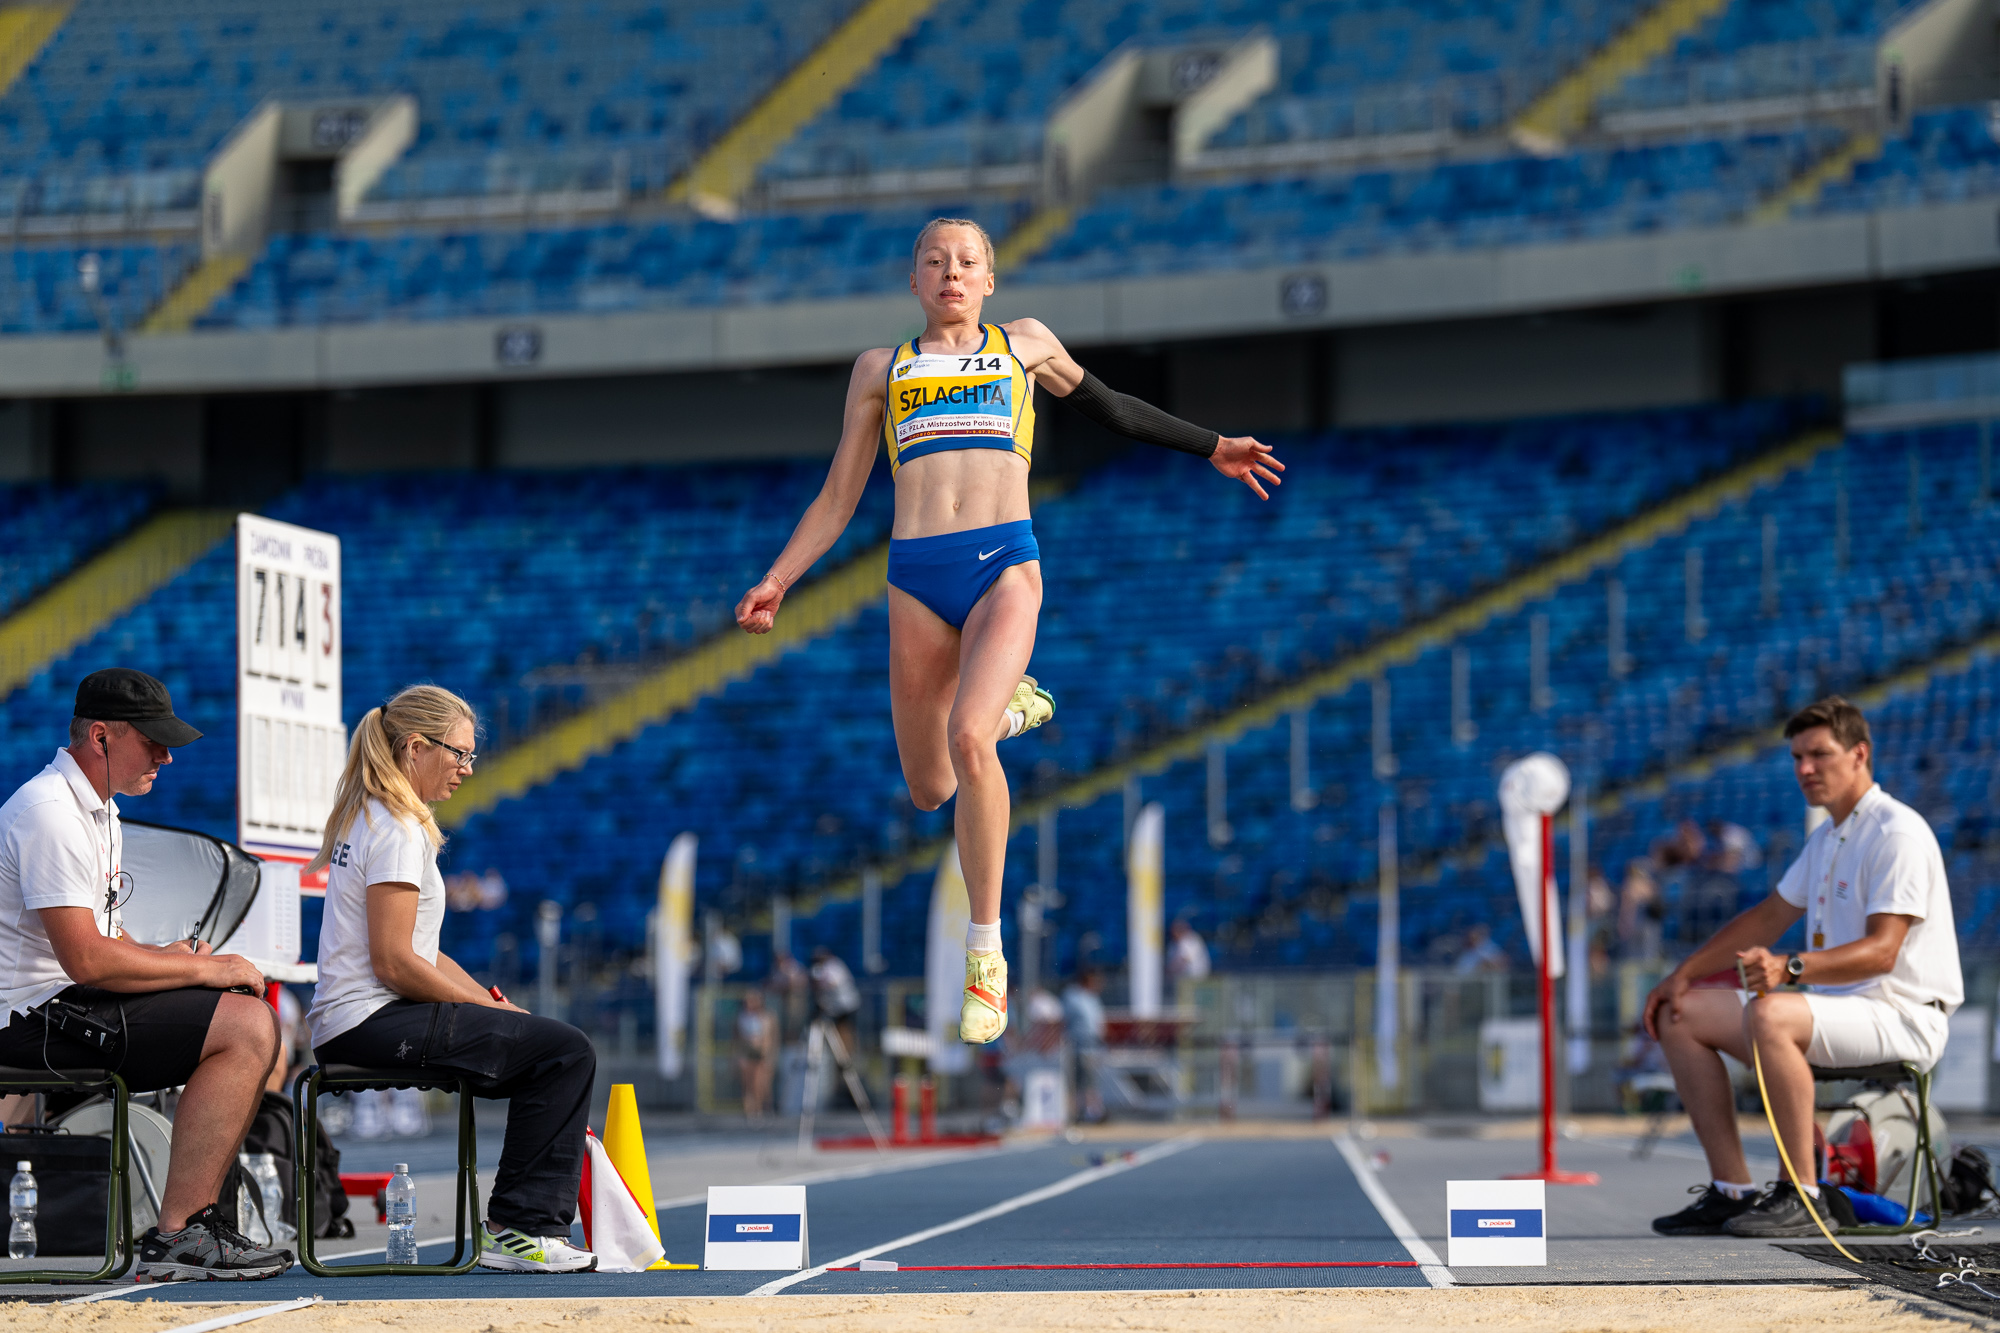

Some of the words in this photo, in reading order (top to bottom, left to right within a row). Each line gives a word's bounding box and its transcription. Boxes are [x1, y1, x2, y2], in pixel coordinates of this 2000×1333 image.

[958, 357, 1002, 372] 714
[899, 384, 1006, 412] SZLACHTA
[899, 424, 908, 436] 55.
[908, 422, 926, 432] PZLA
[926, 420, 971, 428] Mistrzostwa
[973, 419, 995, 427] Polski
[996, 421, 1011, 430] U18
[254, 567, 306, 653] 714
[320, 582, 333, 657] 3
[331, 840, 352, 868] EE
[202, 1208, 213, 1218] FILA
[173, 1236, 188, 1245] FILA
